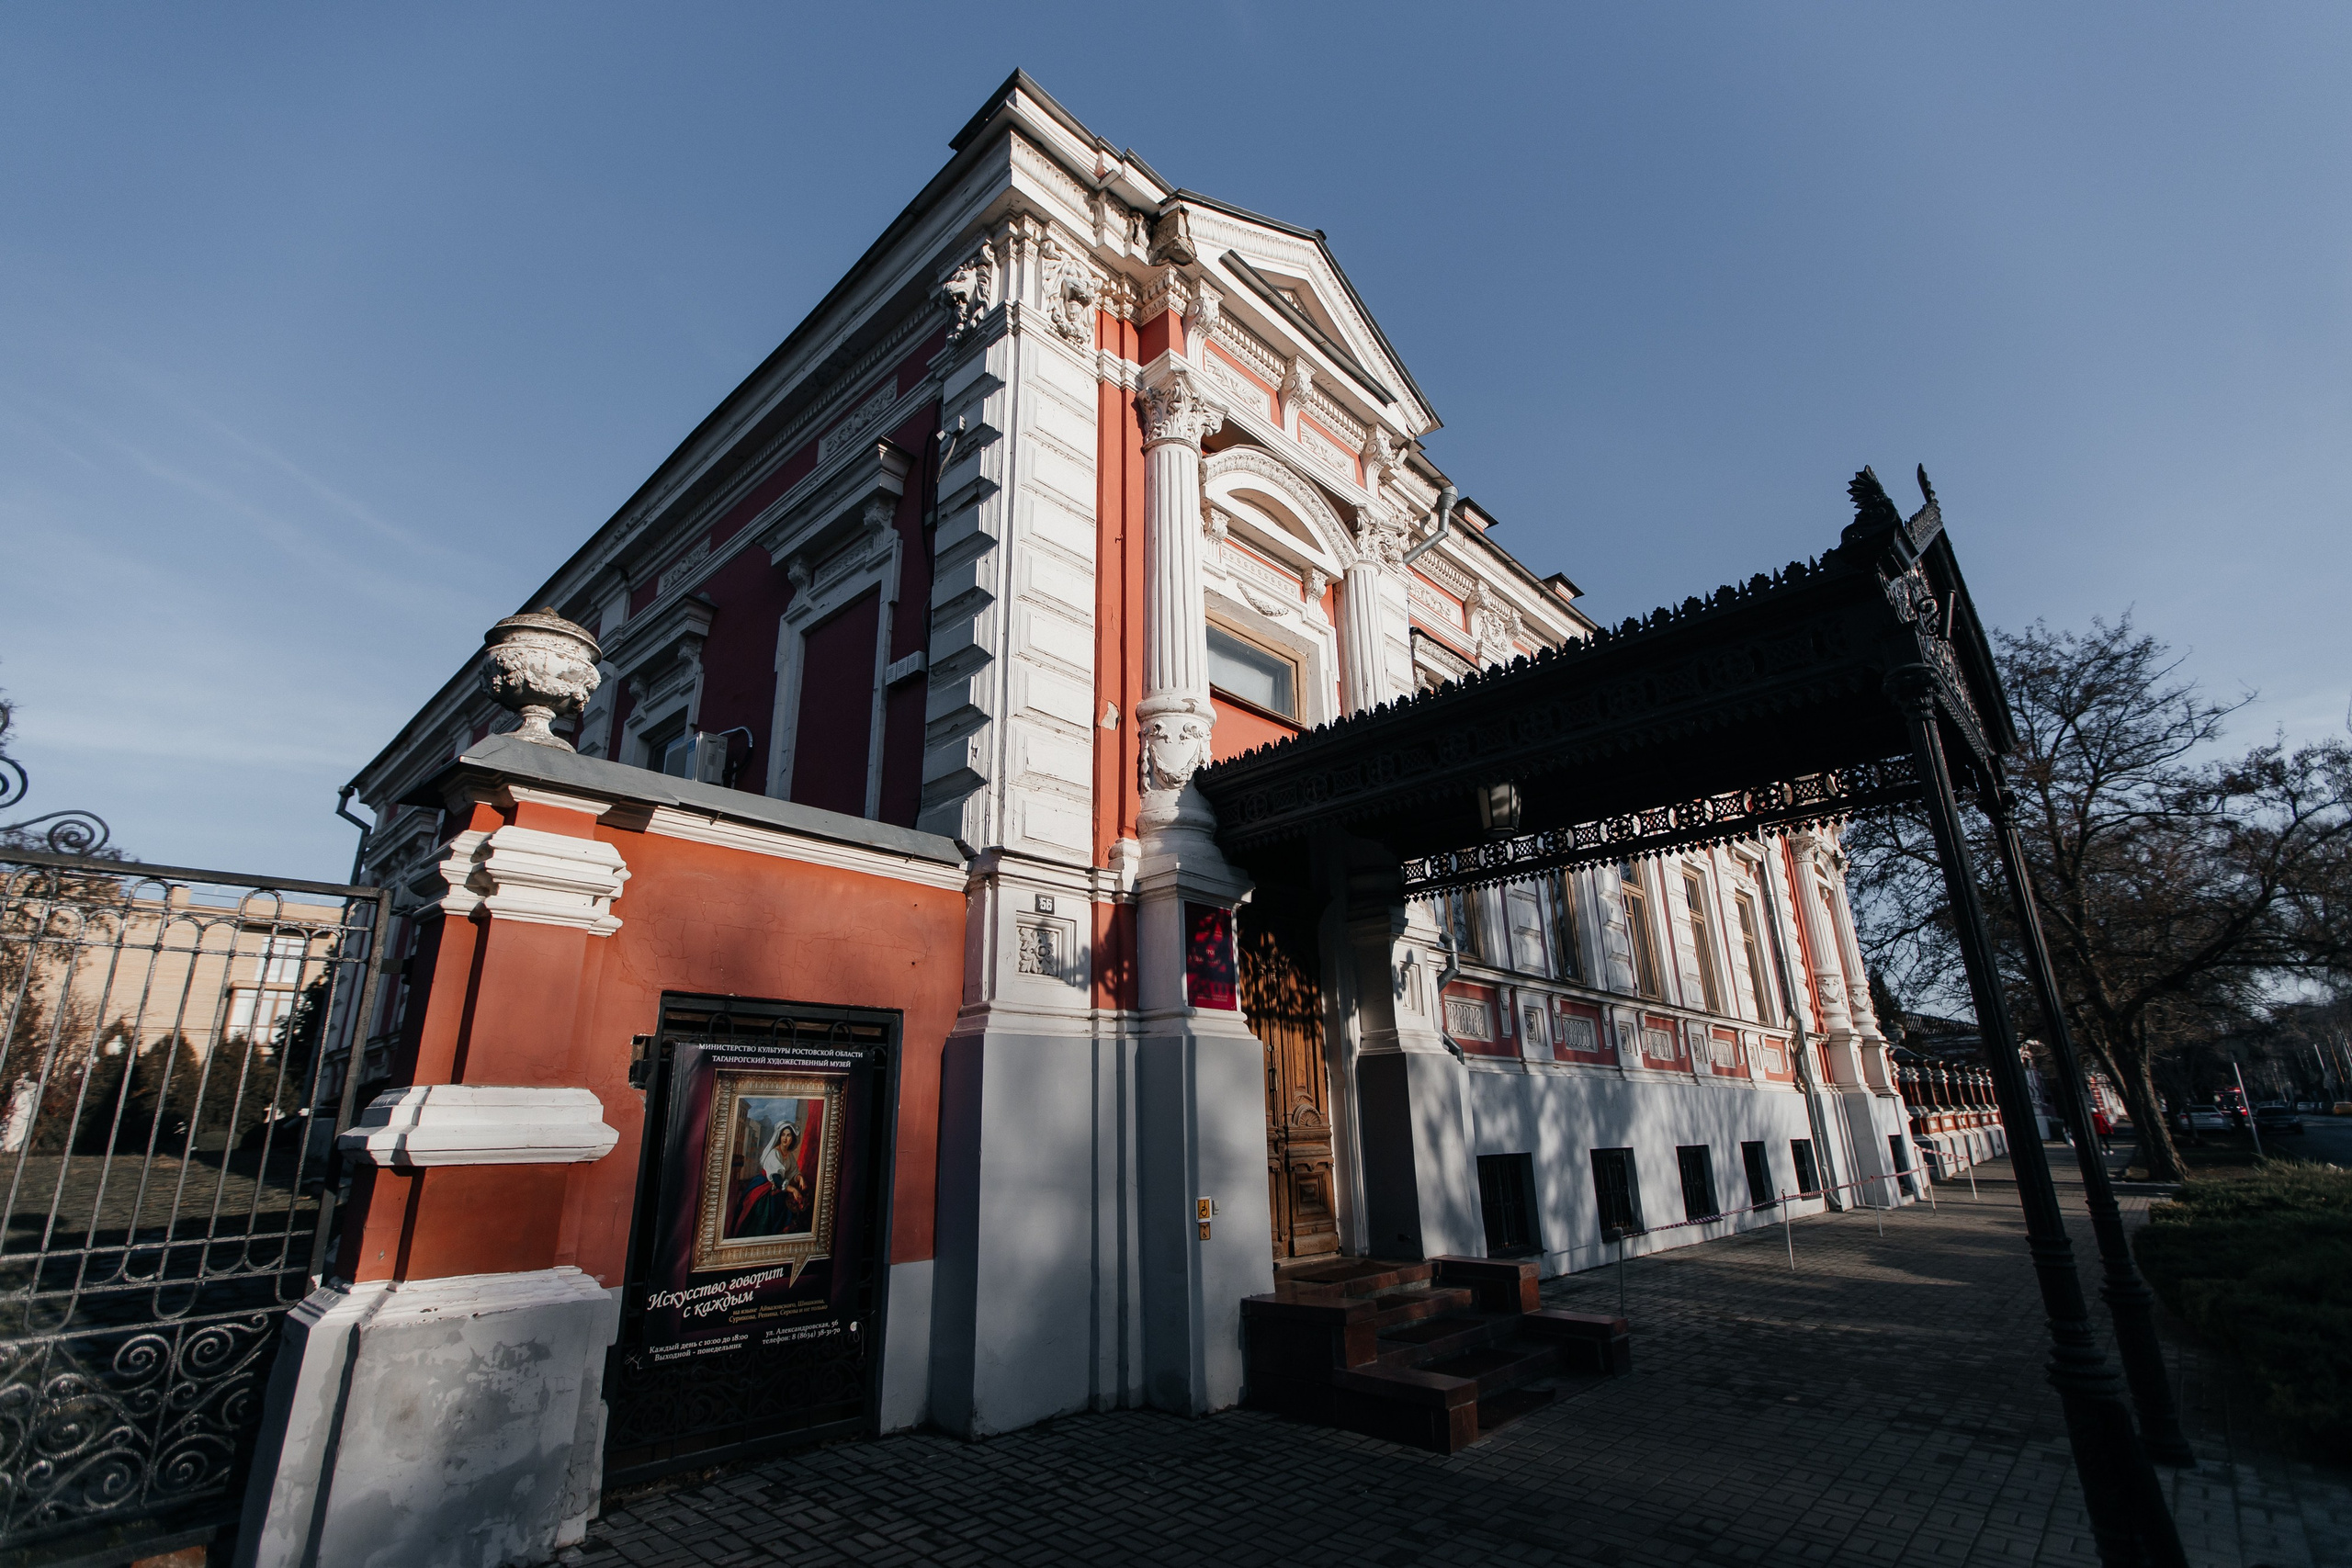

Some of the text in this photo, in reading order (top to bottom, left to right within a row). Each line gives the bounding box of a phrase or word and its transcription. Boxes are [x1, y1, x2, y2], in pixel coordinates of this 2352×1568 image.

[1039, 897, 1053, 911] 56
[698, 1043, 864, 1058] МИНИСТЕРСТВО КУЛЬТУРЫ РОСТОВСКОЙ ОБЛАСТИ
[711, 1055, 852, 1068] ТАГАНРОГСКИЙ ХУДОЖЕСТВЕННЫЙ МУЗЕЙ
[646, 1267, 785, 1311] Искусство говорит
[683, 1291, 754, 1319] с каждым
[762, 1334, 791, 1346] телефон:
[797, 1329, 817, 1340] (8634)
[817, 1327, 842, 1338] 38-31-70
[765, 1319, 840, 1338] ул. Александровская, 56
[649, 1343, 679, 1354] Каждый
[680, 1341, 697, 1350] день
[721, 1337, 731, 1345] до
[731, 1334, 749, 1342] 18:00
[654, 1349, 691, 1361] Выходной
[696, 1342, 743, 1355] понедельник
